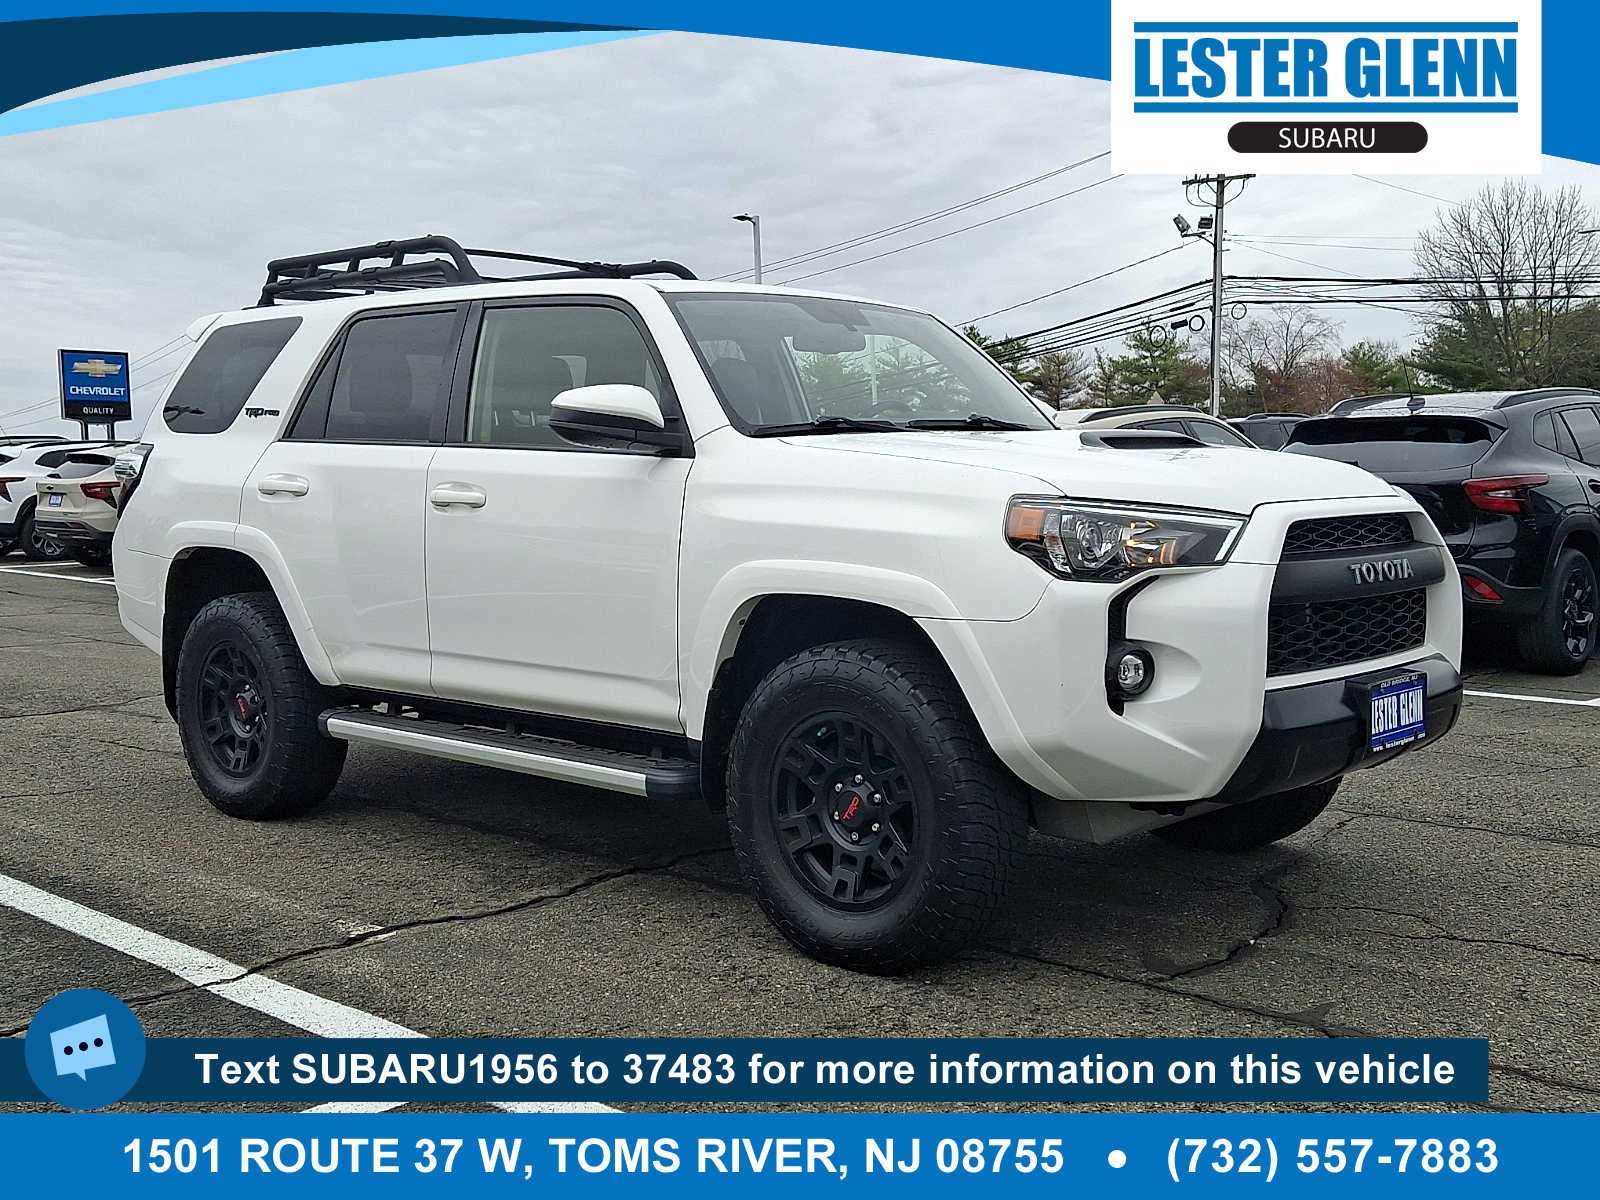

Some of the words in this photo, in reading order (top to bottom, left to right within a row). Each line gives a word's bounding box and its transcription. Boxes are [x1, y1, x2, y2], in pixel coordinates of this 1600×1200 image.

[69, 386, 126, 396] CHEVROLET
[245, 407, 264, 418] TRD
[1351, 559, 1414, 584] TOYOTA
[1371, 695, 1398, 735] LESTER
[1400, 689, 1423, 726] GLENN
[842, 795, 860, 820] TRD
